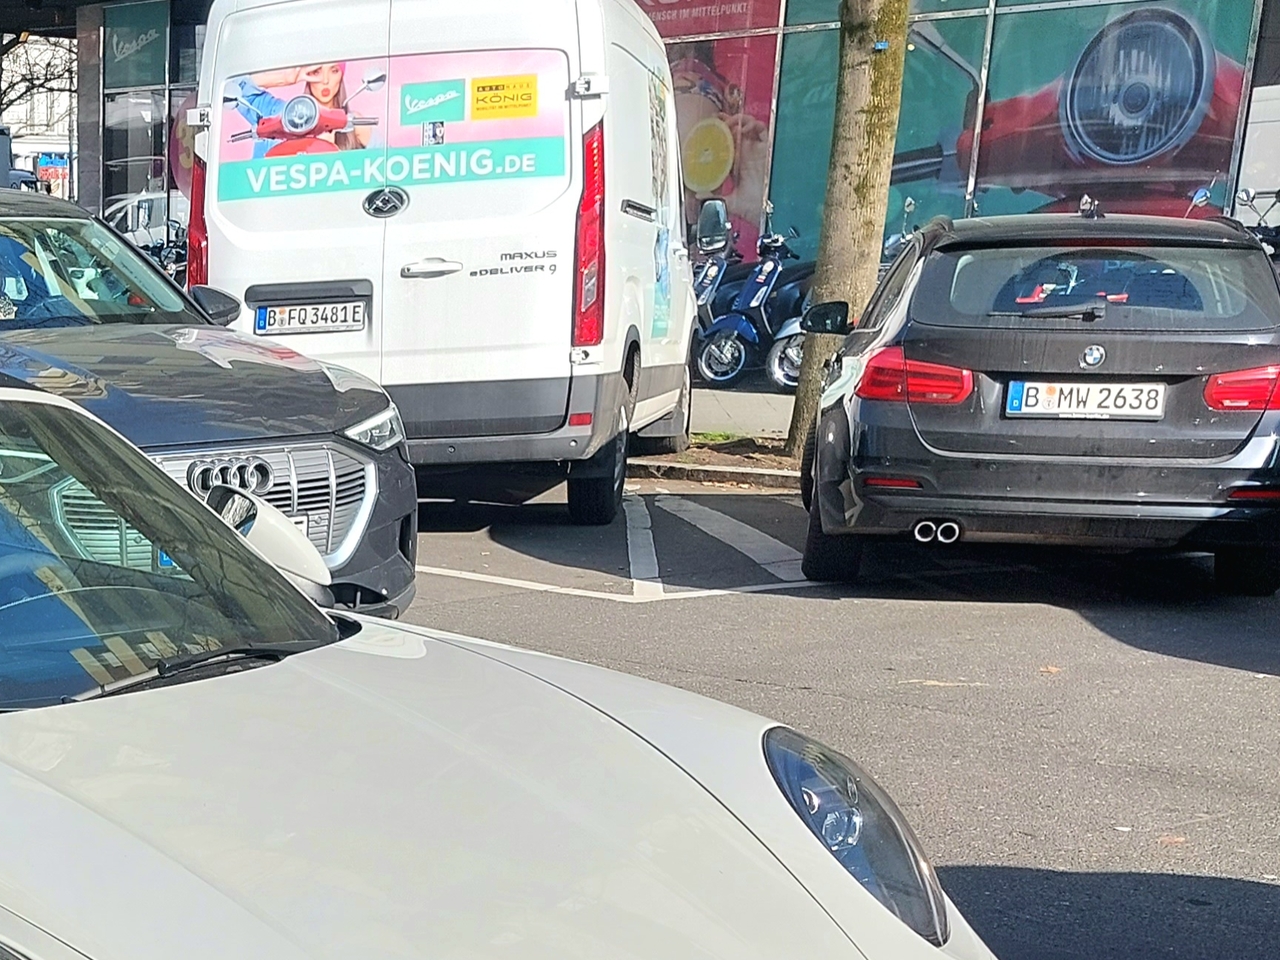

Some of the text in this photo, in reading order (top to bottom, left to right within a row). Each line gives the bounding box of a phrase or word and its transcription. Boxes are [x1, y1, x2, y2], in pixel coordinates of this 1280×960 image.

[680, 9, 689, 19] IM
[692, 3, 747, 18] MITTELPUNKT
[113, 29, 160, 62] Vespa
[405, 90, 461, 115] Vespa
[476, 93, 532, 105] KÖNIG
[246, 149, 536, 193] VESPA-KOENIG.DE
[500, 251, 557, 261] MAXUS
[469, 264, 557, 277] eDELIVER 9
[268, 310, 276, 326] B
[288, 308, 307, 326] FQ
[1024, 386, 1039, 408] B
[1057, 387, 1090, 409] MW
[1097, 388, 1159, 410] 2638
